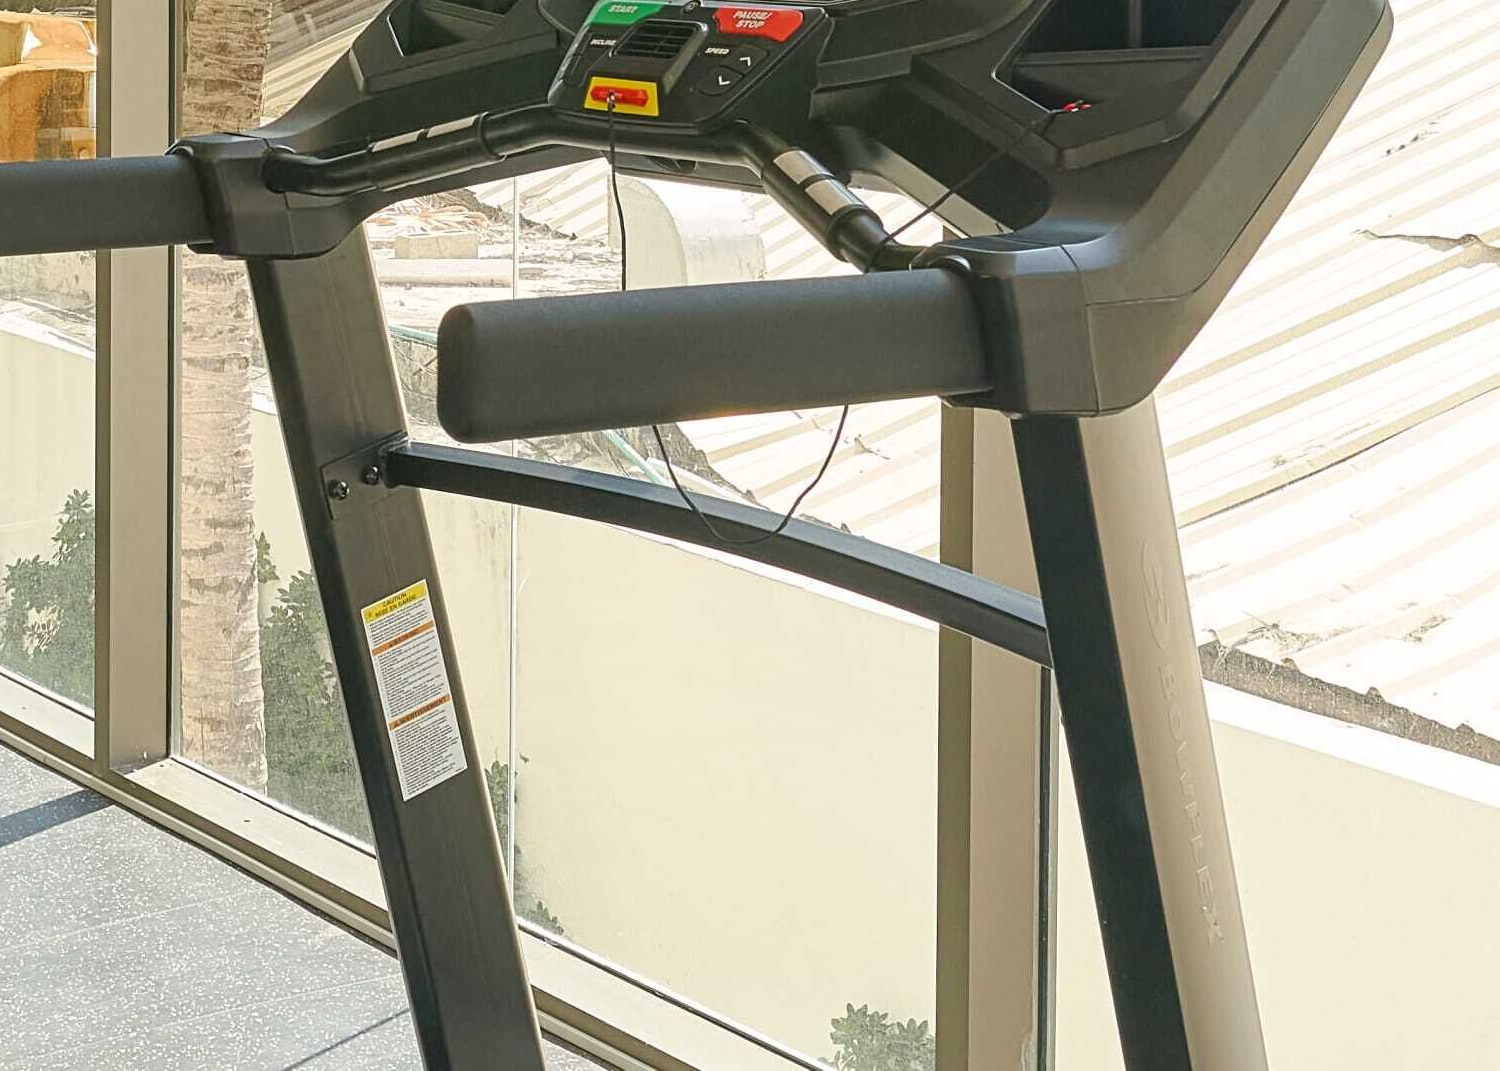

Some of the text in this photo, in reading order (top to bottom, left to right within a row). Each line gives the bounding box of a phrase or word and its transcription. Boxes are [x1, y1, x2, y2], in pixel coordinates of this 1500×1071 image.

[608, 5, 638, 14] START
[732, 10, 772, 20] PAUSE/
[734, 20, 766, 29] STOP
[705, 47, 730, 55] SPEED
[1156, 662, 1228, 948] BOWFLEX
